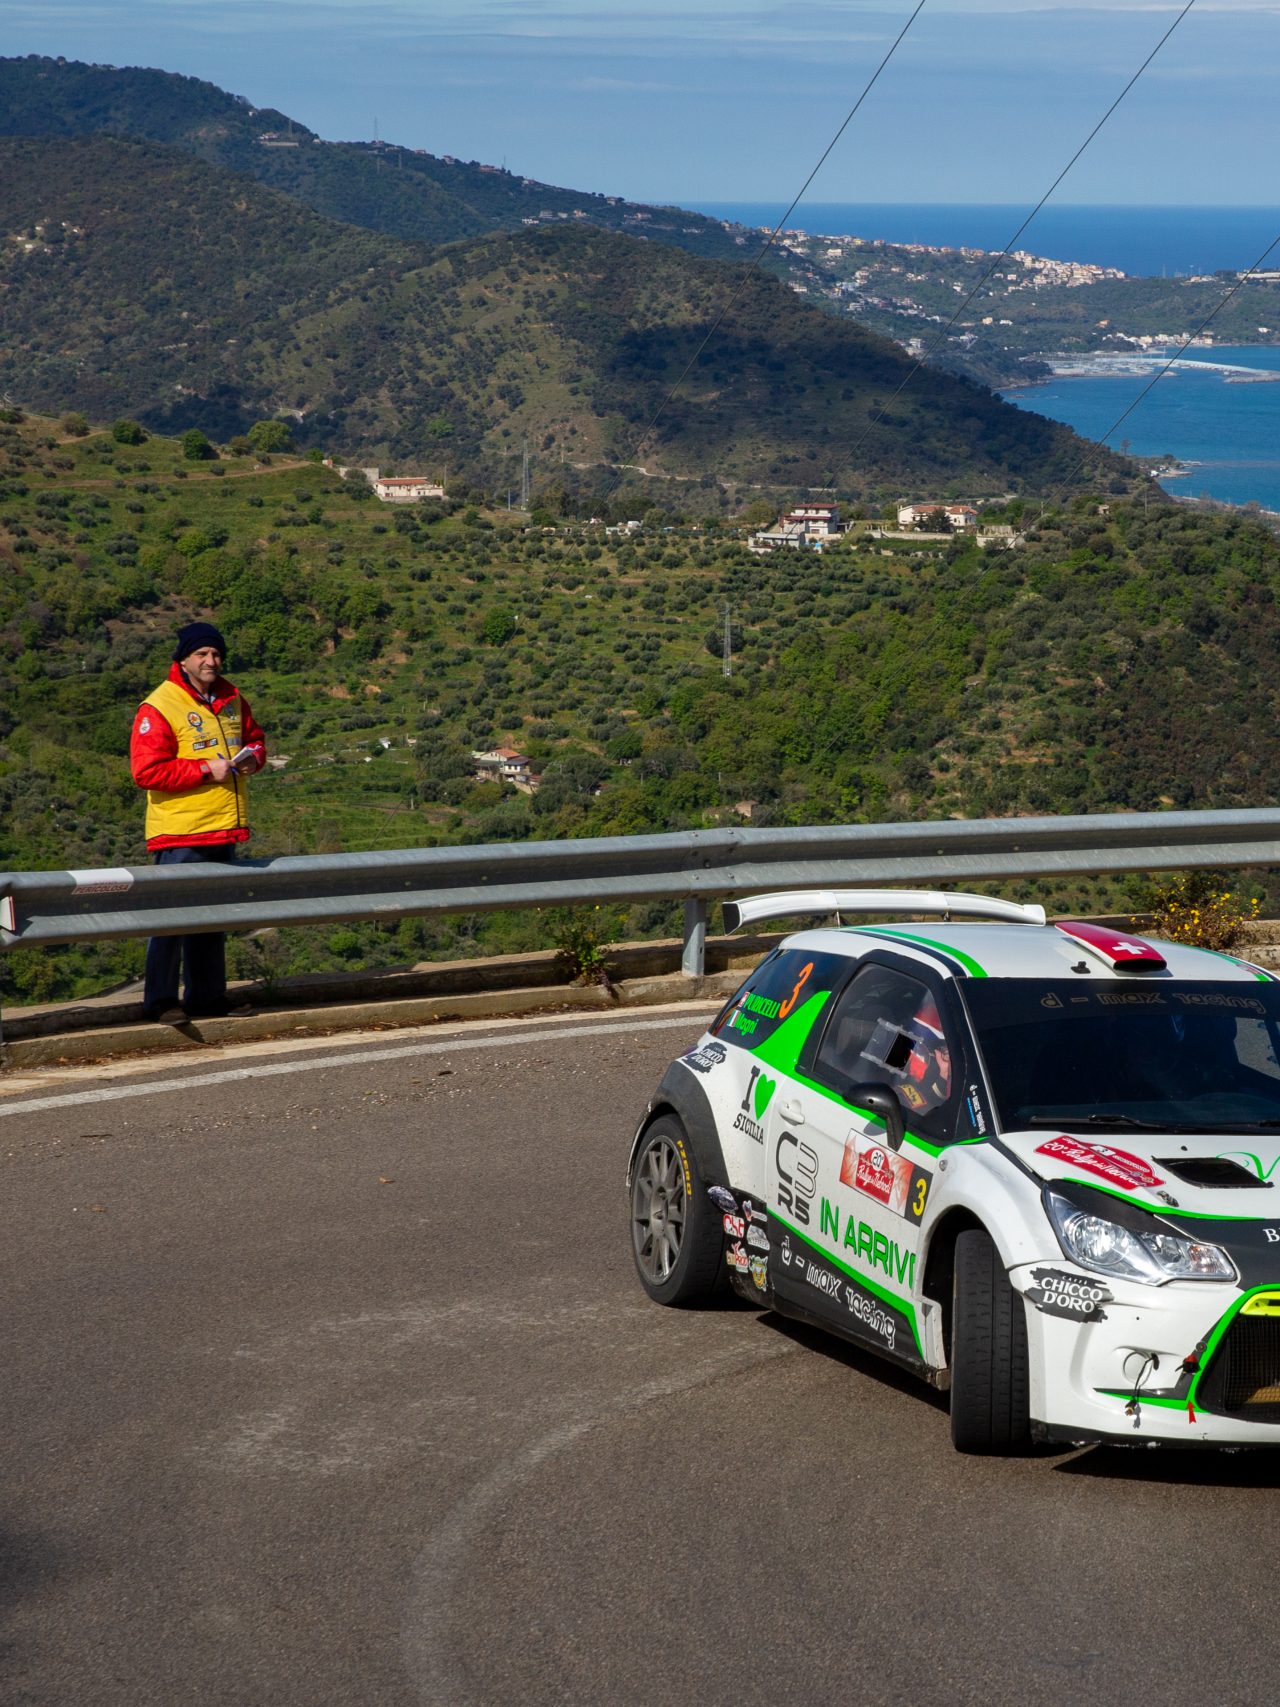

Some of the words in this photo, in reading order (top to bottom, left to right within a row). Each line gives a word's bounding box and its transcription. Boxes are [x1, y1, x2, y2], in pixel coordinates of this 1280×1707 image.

[779, 962, 814, 1018] 3
[1096, 993, 1167, 1004] max
[1172, 993, 1267, 1014] racing
[742, 1065, 760, 1112] I
[733, 1113, 764, 1145] SICILIA
[776, 1131, 819, 1199] C3
[913, 1179, 927, 1216] 3
[820, 1196, 839, 1242] IN
[806, 1262, 842, 1303] max
[845, 1286, 897, 1350] racing
[1041, 1277, 1103, 1301] CHICCO
[1043, 1290, 1095, 1313] D'ORO
